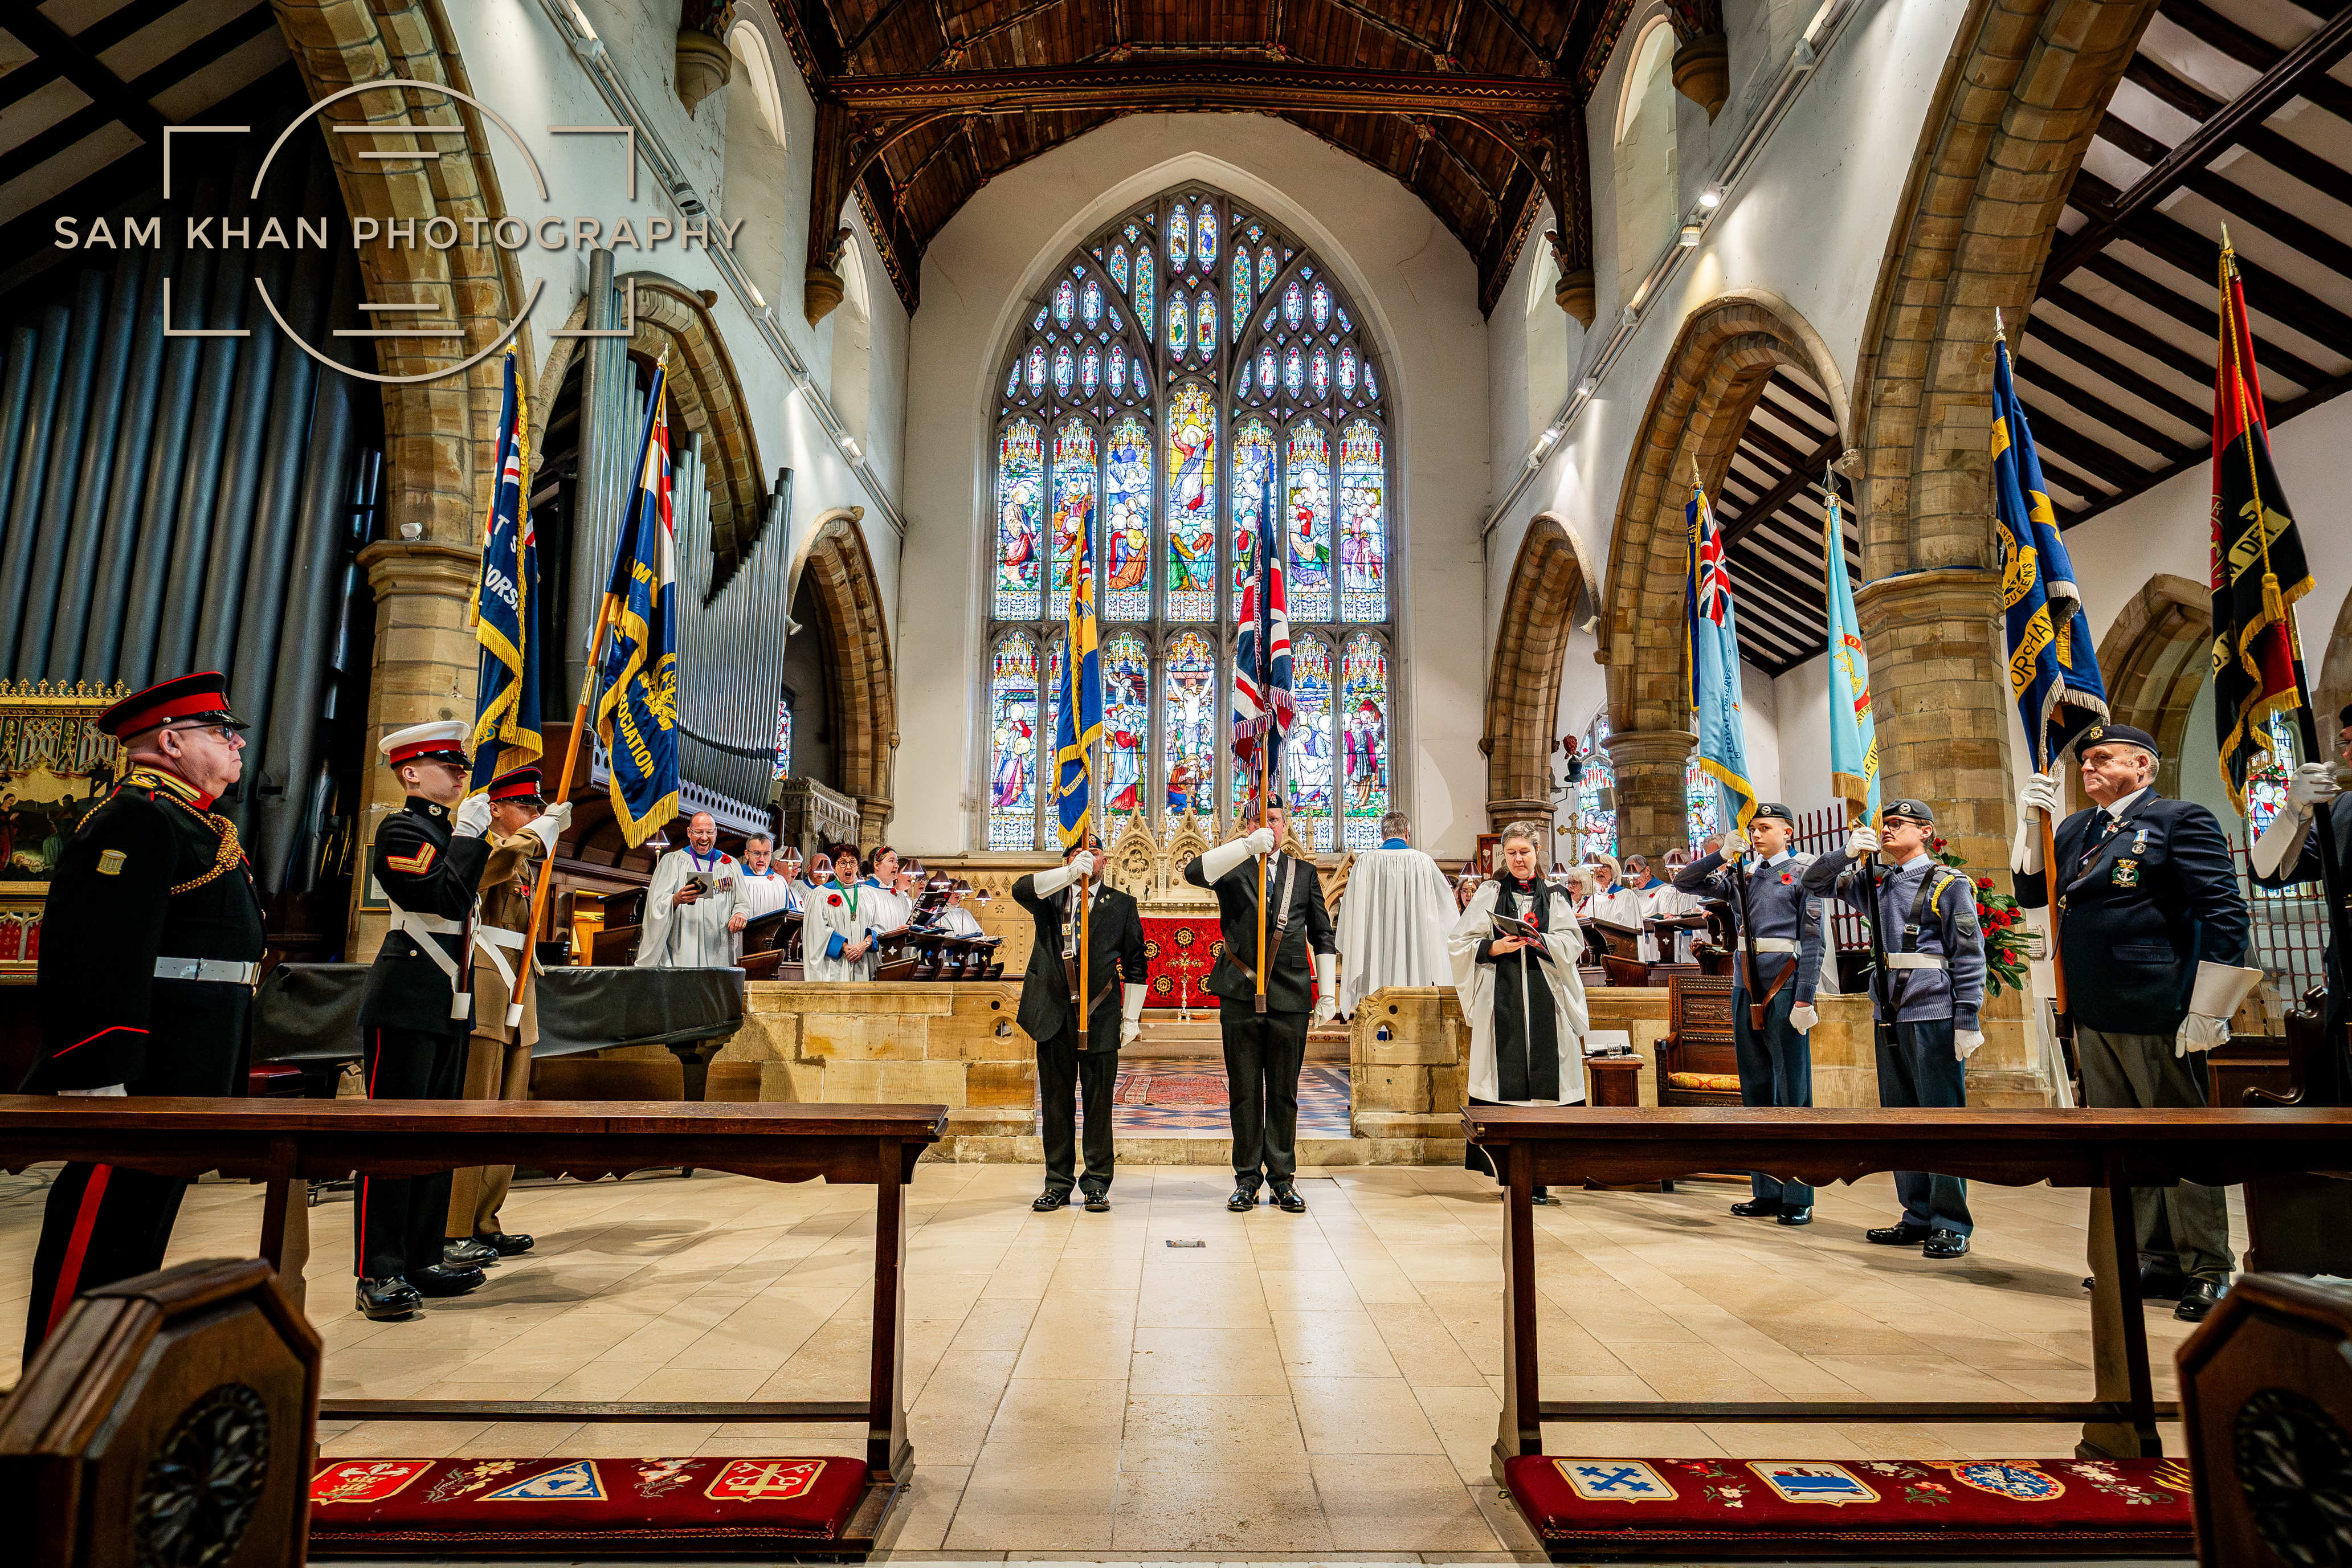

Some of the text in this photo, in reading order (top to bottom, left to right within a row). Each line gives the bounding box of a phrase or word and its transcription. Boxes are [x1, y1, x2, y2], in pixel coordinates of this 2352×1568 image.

[1998, 522, 2015, 550] ENSE
[1723, 668, 1733, 754] ROYAL OBSERV
[1065, 776, 1082, 793] YPRES
